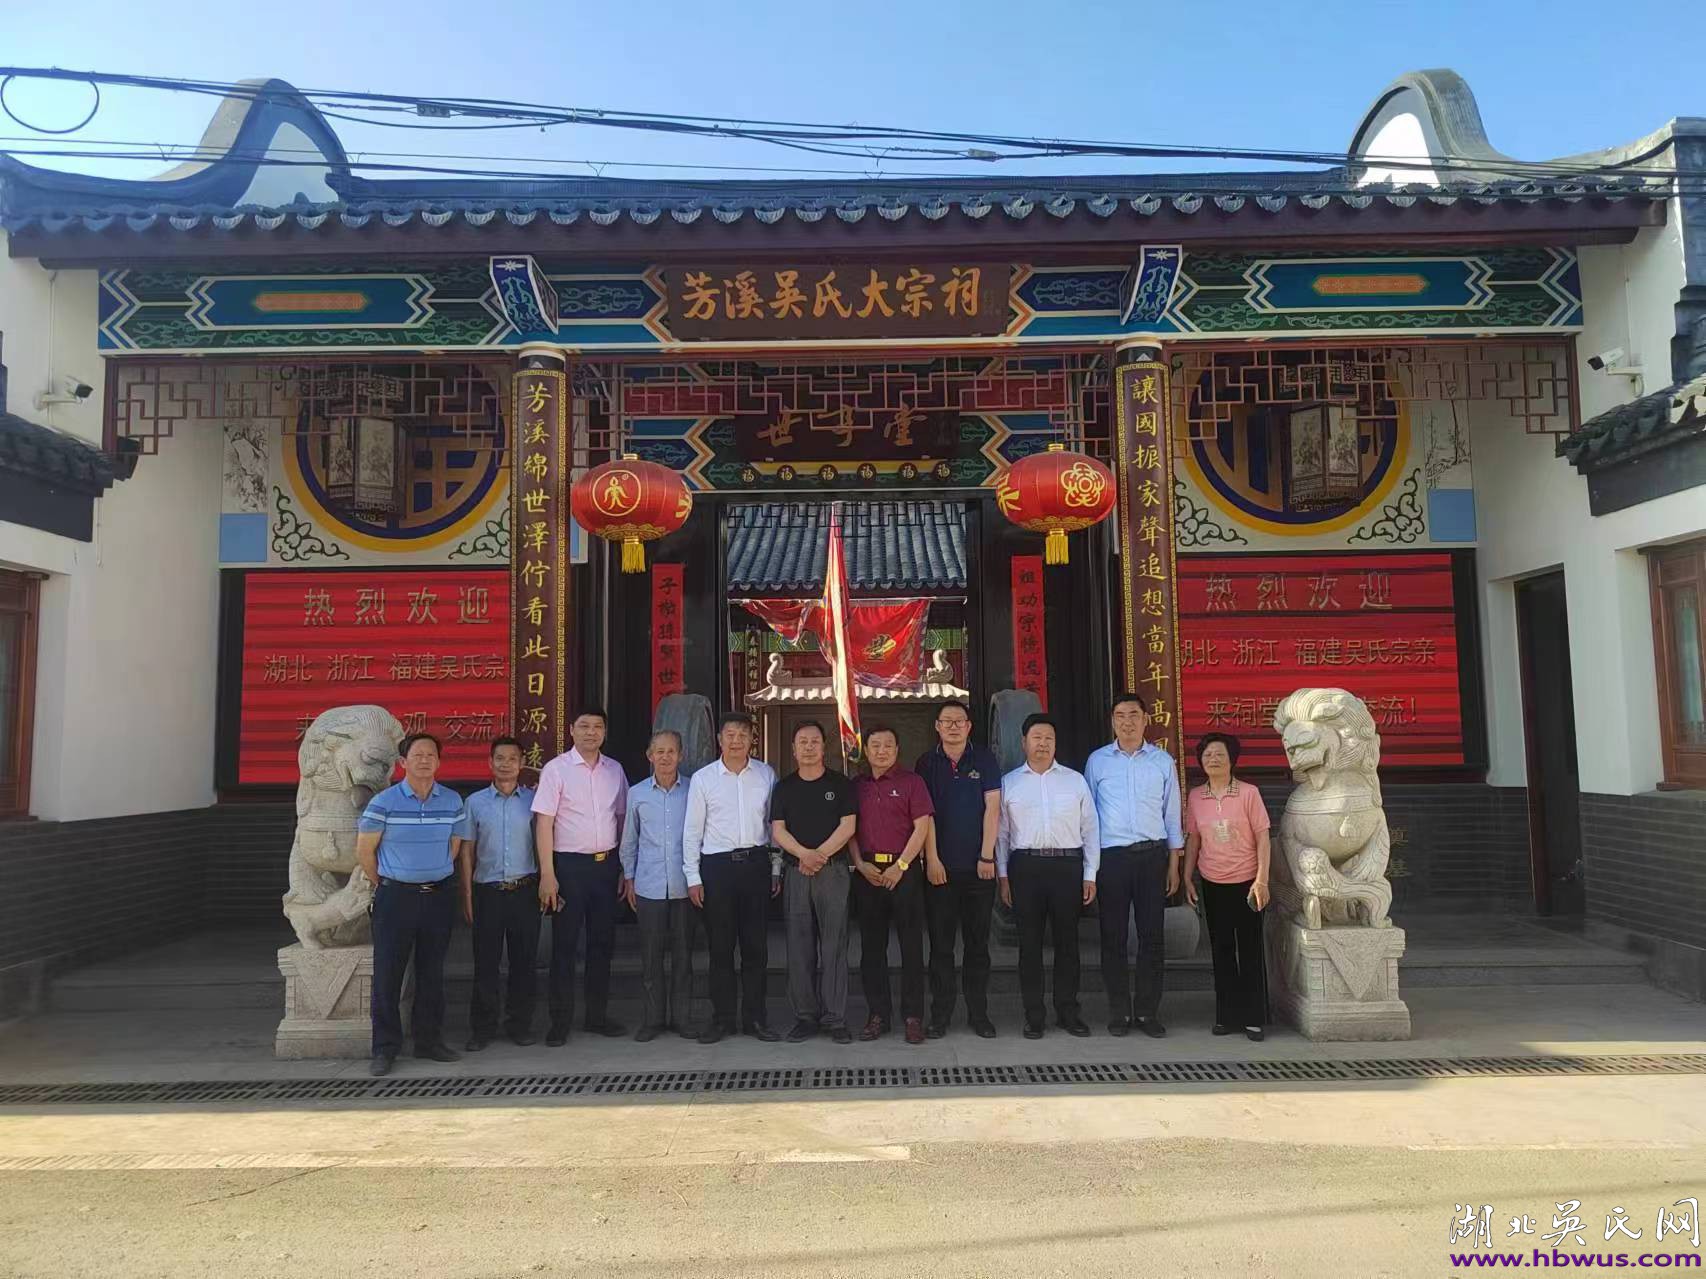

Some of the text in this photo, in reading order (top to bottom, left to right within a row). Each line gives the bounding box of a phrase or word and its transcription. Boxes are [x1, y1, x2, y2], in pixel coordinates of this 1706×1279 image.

[303, 586, 492, 627] 热烈欢迎
[1205, 571, 1393, 611] 热烈欢迎
[263, 651, 511, 682] 湖北 浙江 福建吴氏宗
[1231, 638, 1281, 665] 浙江
[1294, 637, 1437, 666] 福建吴氏宗亲
